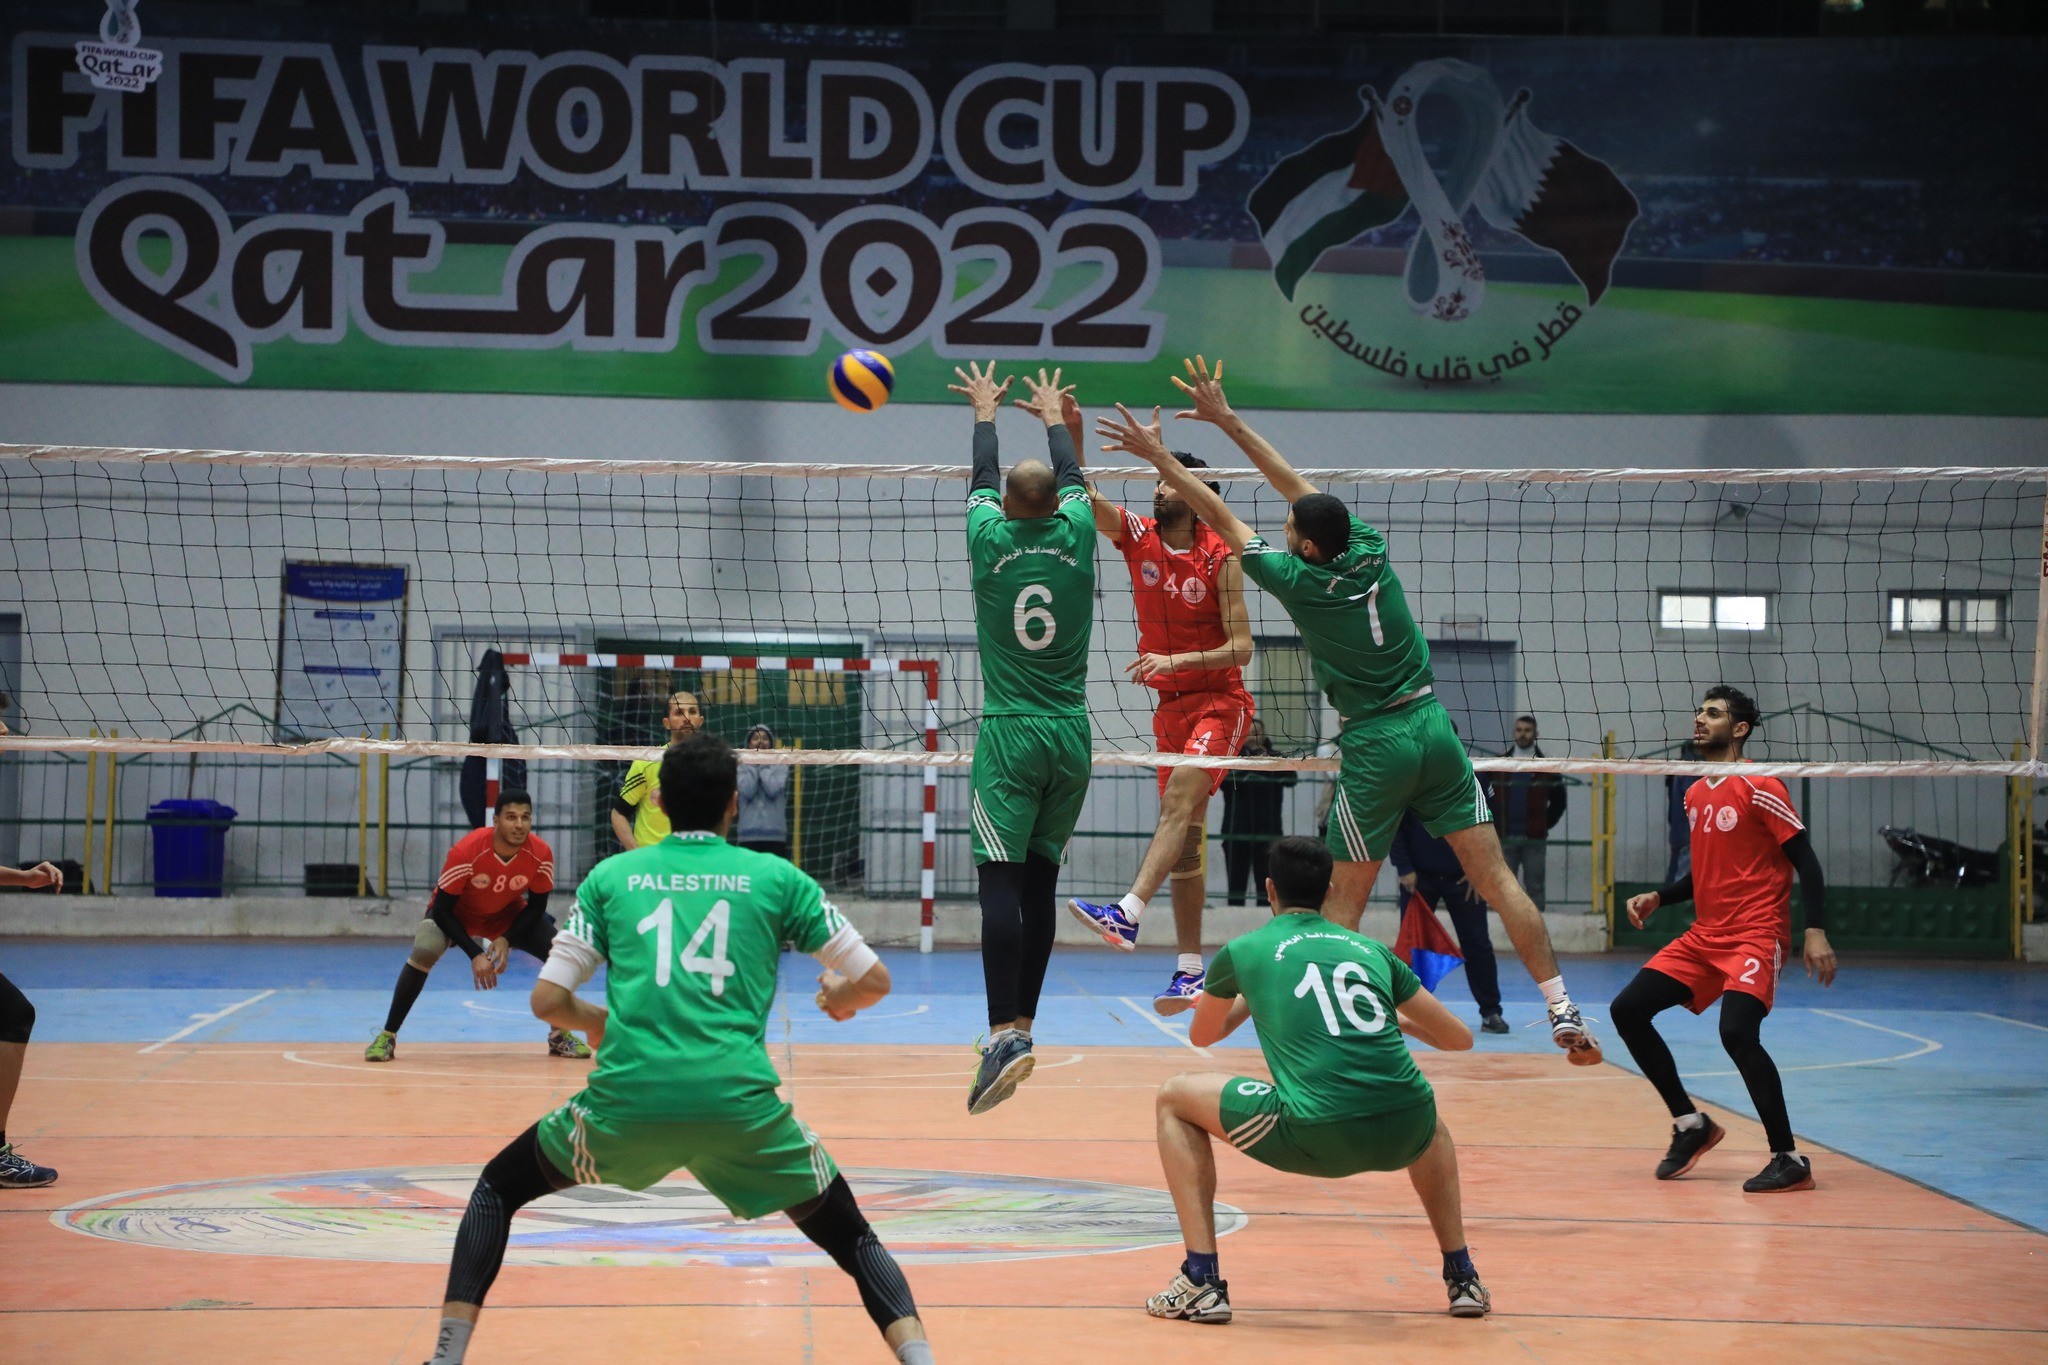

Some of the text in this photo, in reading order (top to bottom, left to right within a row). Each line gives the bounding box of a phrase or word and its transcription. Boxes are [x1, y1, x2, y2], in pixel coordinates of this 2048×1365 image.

[81, 45, 157, 60] FIFA WORLD CUP
[82, 54, 156, 78] Qatar
[105, 75, 139, 88] 2022
[25, 46, 1238, 188] FIFA WORLD CUP
[89, 189, 1152, 368] Qatar 2022
[1300, 301, 1582, 389] قطر في قلب فلسطين
[1163, 572, 1179, 599] 4
[1014, 584, 1056, 651] 6
[1192, 730, 1212, 756] 4
[1703, 804, 1713, 833] 2
[493, 874, 507, 893] 8
[627, 873, 751, 893] PALESTINE
[636, 898, 735, 997] 14
[1739, 958, 1760, 985] 2
[1294, 961, 1387, 1036] 16
